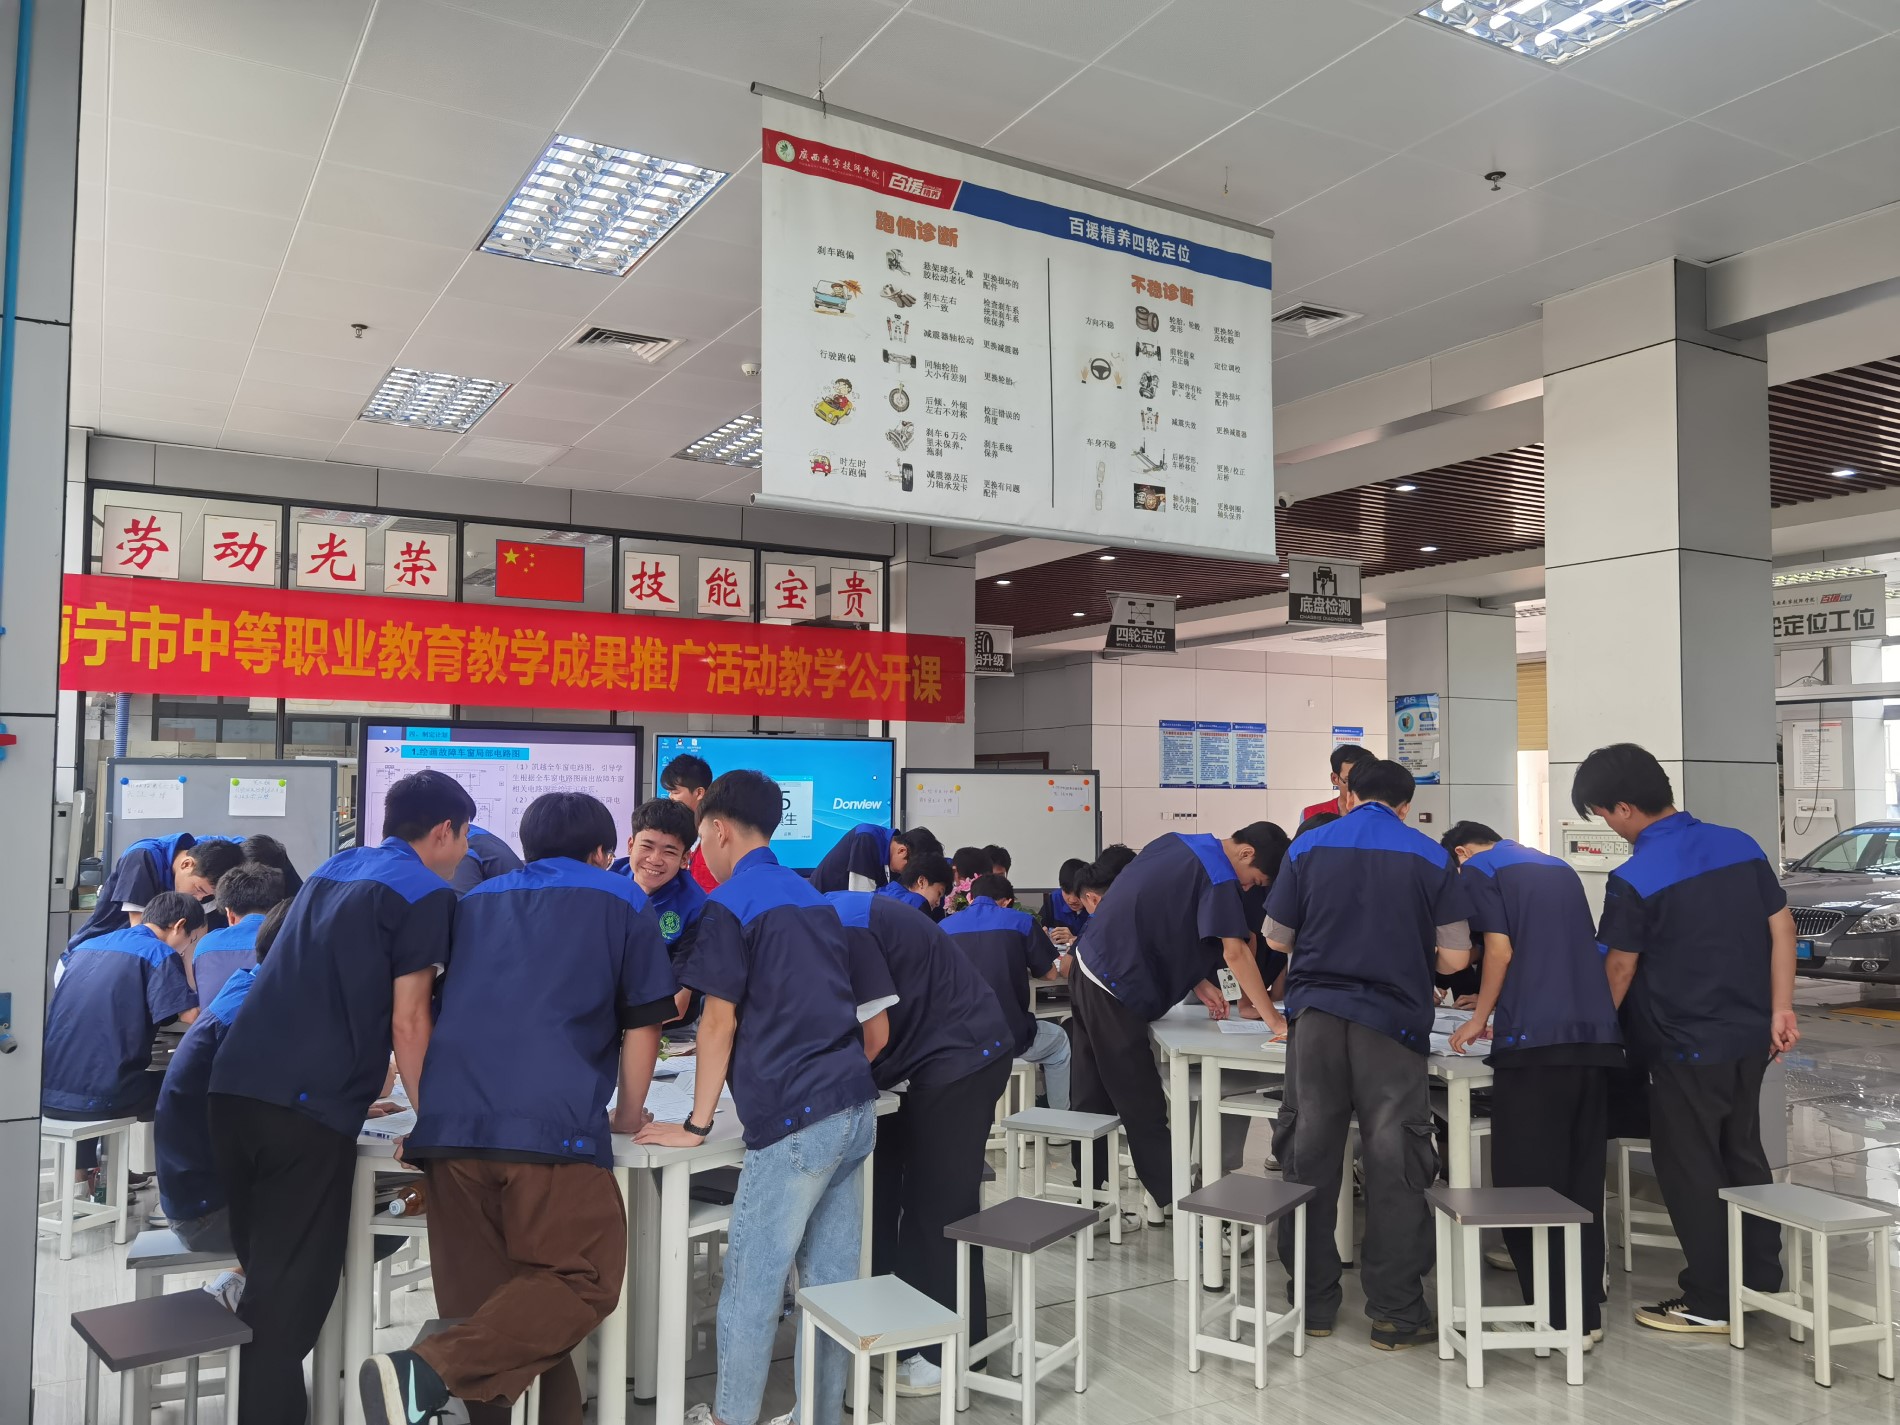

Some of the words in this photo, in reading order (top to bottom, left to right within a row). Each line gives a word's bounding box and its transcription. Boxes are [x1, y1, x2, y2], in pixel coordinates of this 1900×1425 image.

[876, 210, 959, 247] 跑偏诊断
[1069, 216, 1191, 264] 百援精养四轮定位
[817, 245, 855, 261] 刹车跑偏
[983, 281, 998, 292] 配件
[1131, 274, 1194, 307] 不稳诊断
[923, 292, 957, 306] 刹车左右
[923, 301, 949, 313] 不一致
[983, 315, 1006, 329] 统保养
[1085, 316, 1115, 330] 方向不稳
[1213, 326, 1241, 338] 更换轮胎
[983, 339, 1020, 356] 更换减震器
[820, 349, 856, 364] 行驶跑偏
[924, 359, 959, 373] 同轴轮胎
[924, 369, 967, 384] 大小有差别
[984, 371, 1013, 386] 更换轮胎
[925, 405, 968, 419] 左右不对称
[984, 405, 1021, 421] 校正错误的
[984, 414, 998, 426] 角度
[984, 440, 1013, 453] 刹车系统
[1086, 437, 1117, 450] 车身不稳
[984, 448, 998, 459] 保养
[840, 457, 867, 469] 时左时
[840, 467, 867, 479] 右跑偏
[983, 479, 1021, 494] 更换有问题
[983, 488, 998, 499] 配件
[116, 515, 438, 588] 劳动光荣
[629, 560, 872, 618] 技能宝贵
[1300, 596, 1351, 616] 底盘检测
[1116, 627, 1166, 644] 四轮定位
[832, 798, 883, 810] Donview
